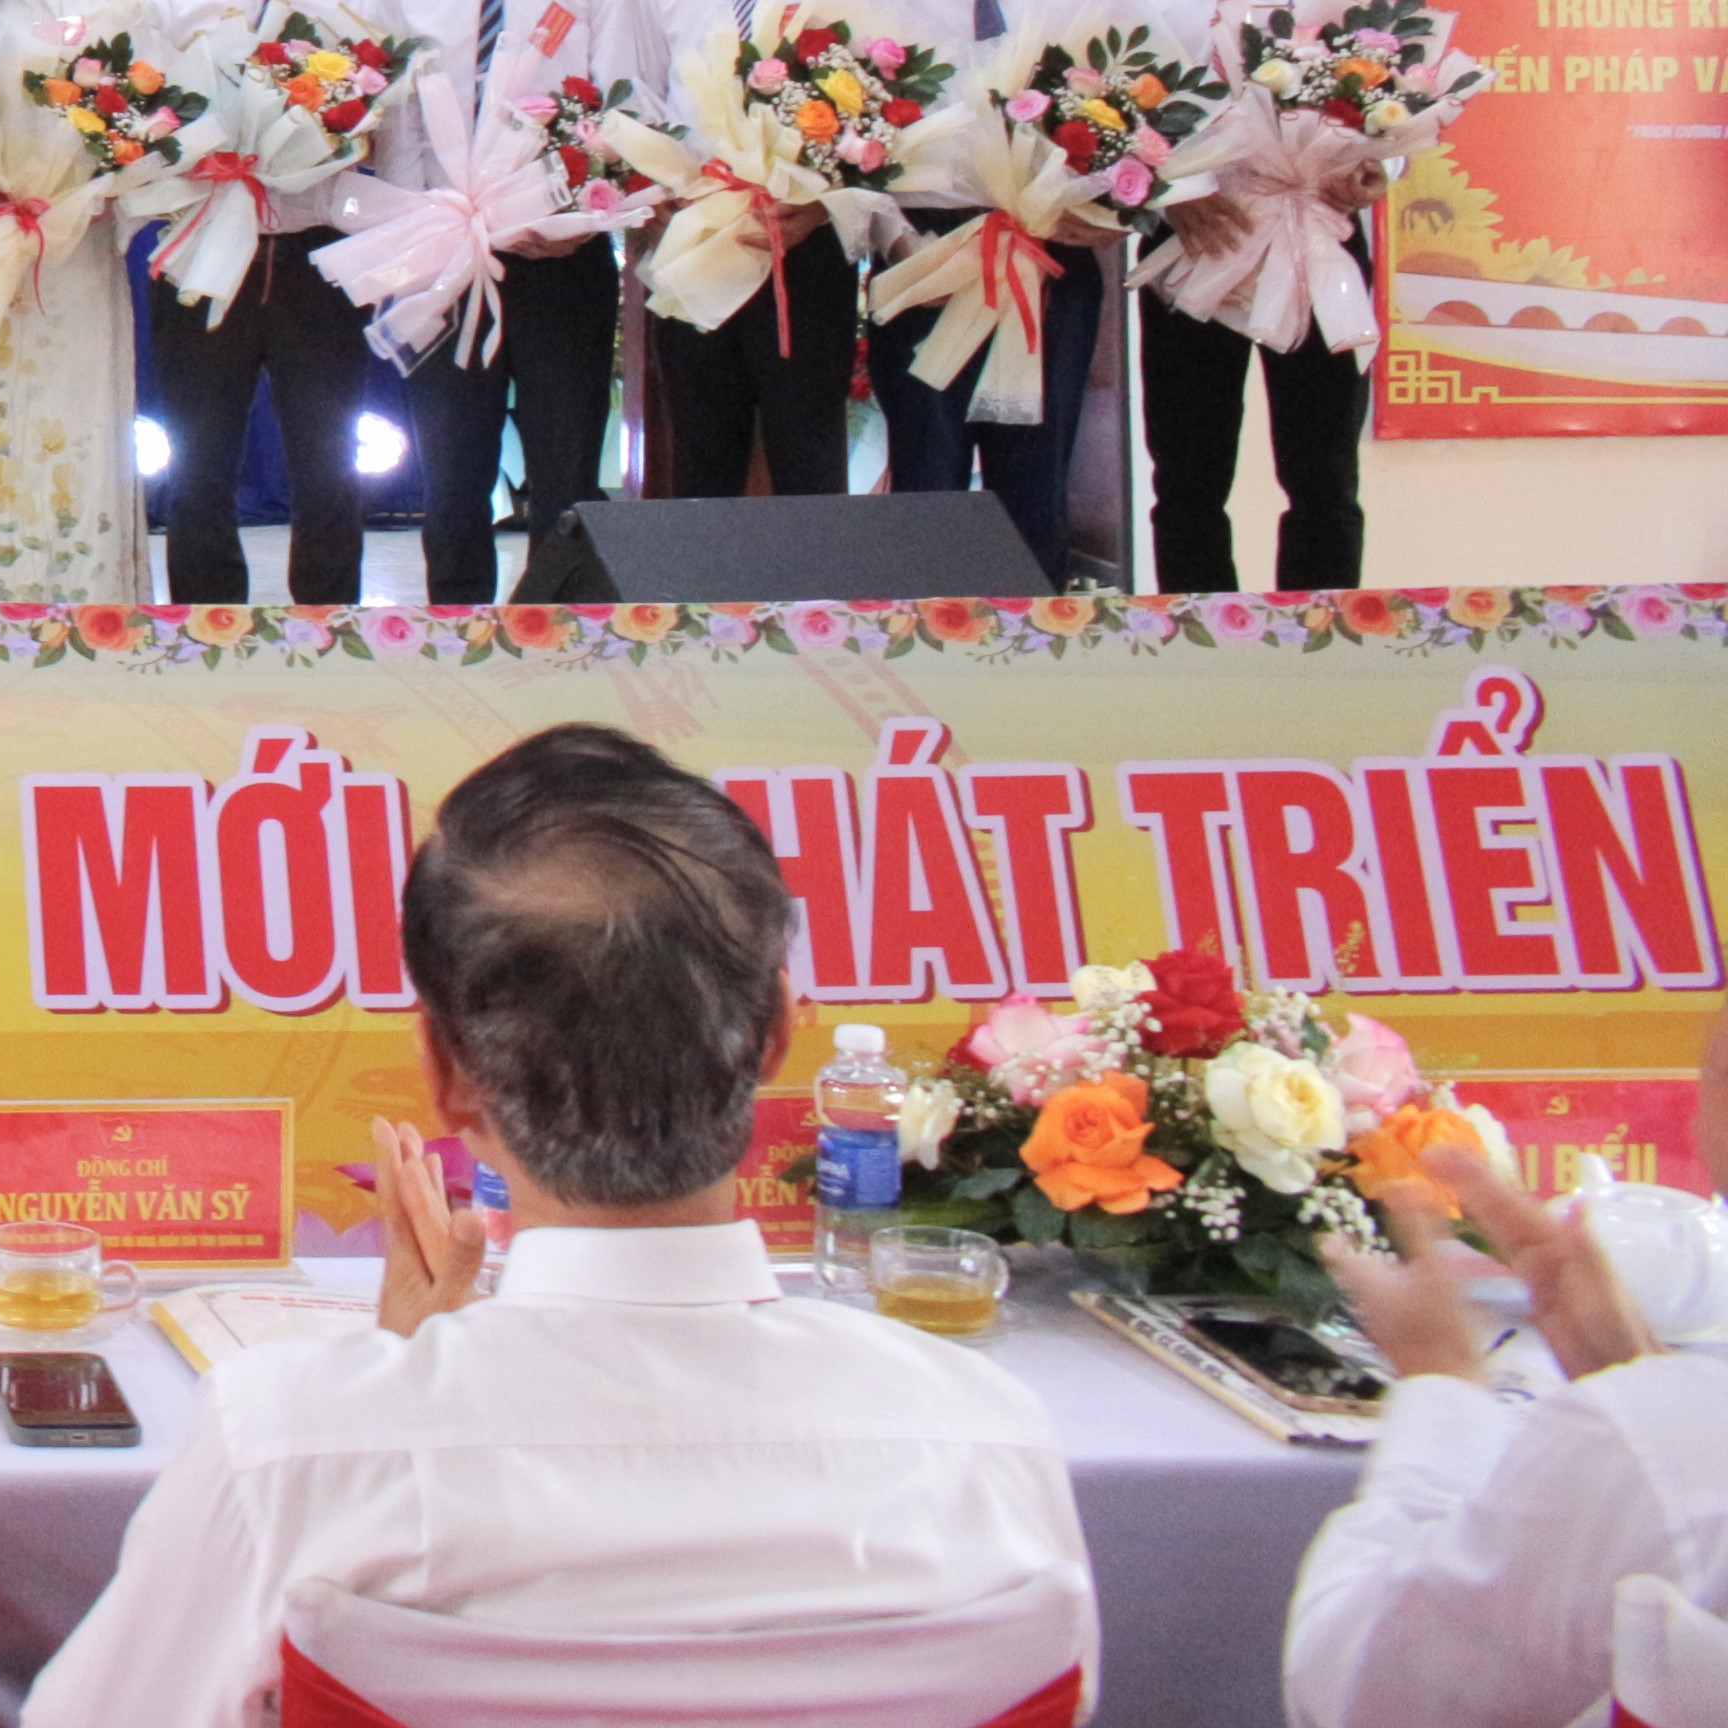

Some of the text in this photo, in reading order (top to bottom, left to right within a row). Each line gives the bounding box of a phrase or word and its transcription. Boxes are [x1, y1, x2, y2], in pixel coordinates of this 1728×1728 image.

[1564, 48, 1679, 93] PHÁP
[20, 725, 418, 1013] MỚI
[715, 715, 1092, 1002] HÁT
[1119, 667, 1724, 994] TRIỂN
[136, 1182, 204, 1221] VĂN
[211, 1182, 252, 1221] SỸ
